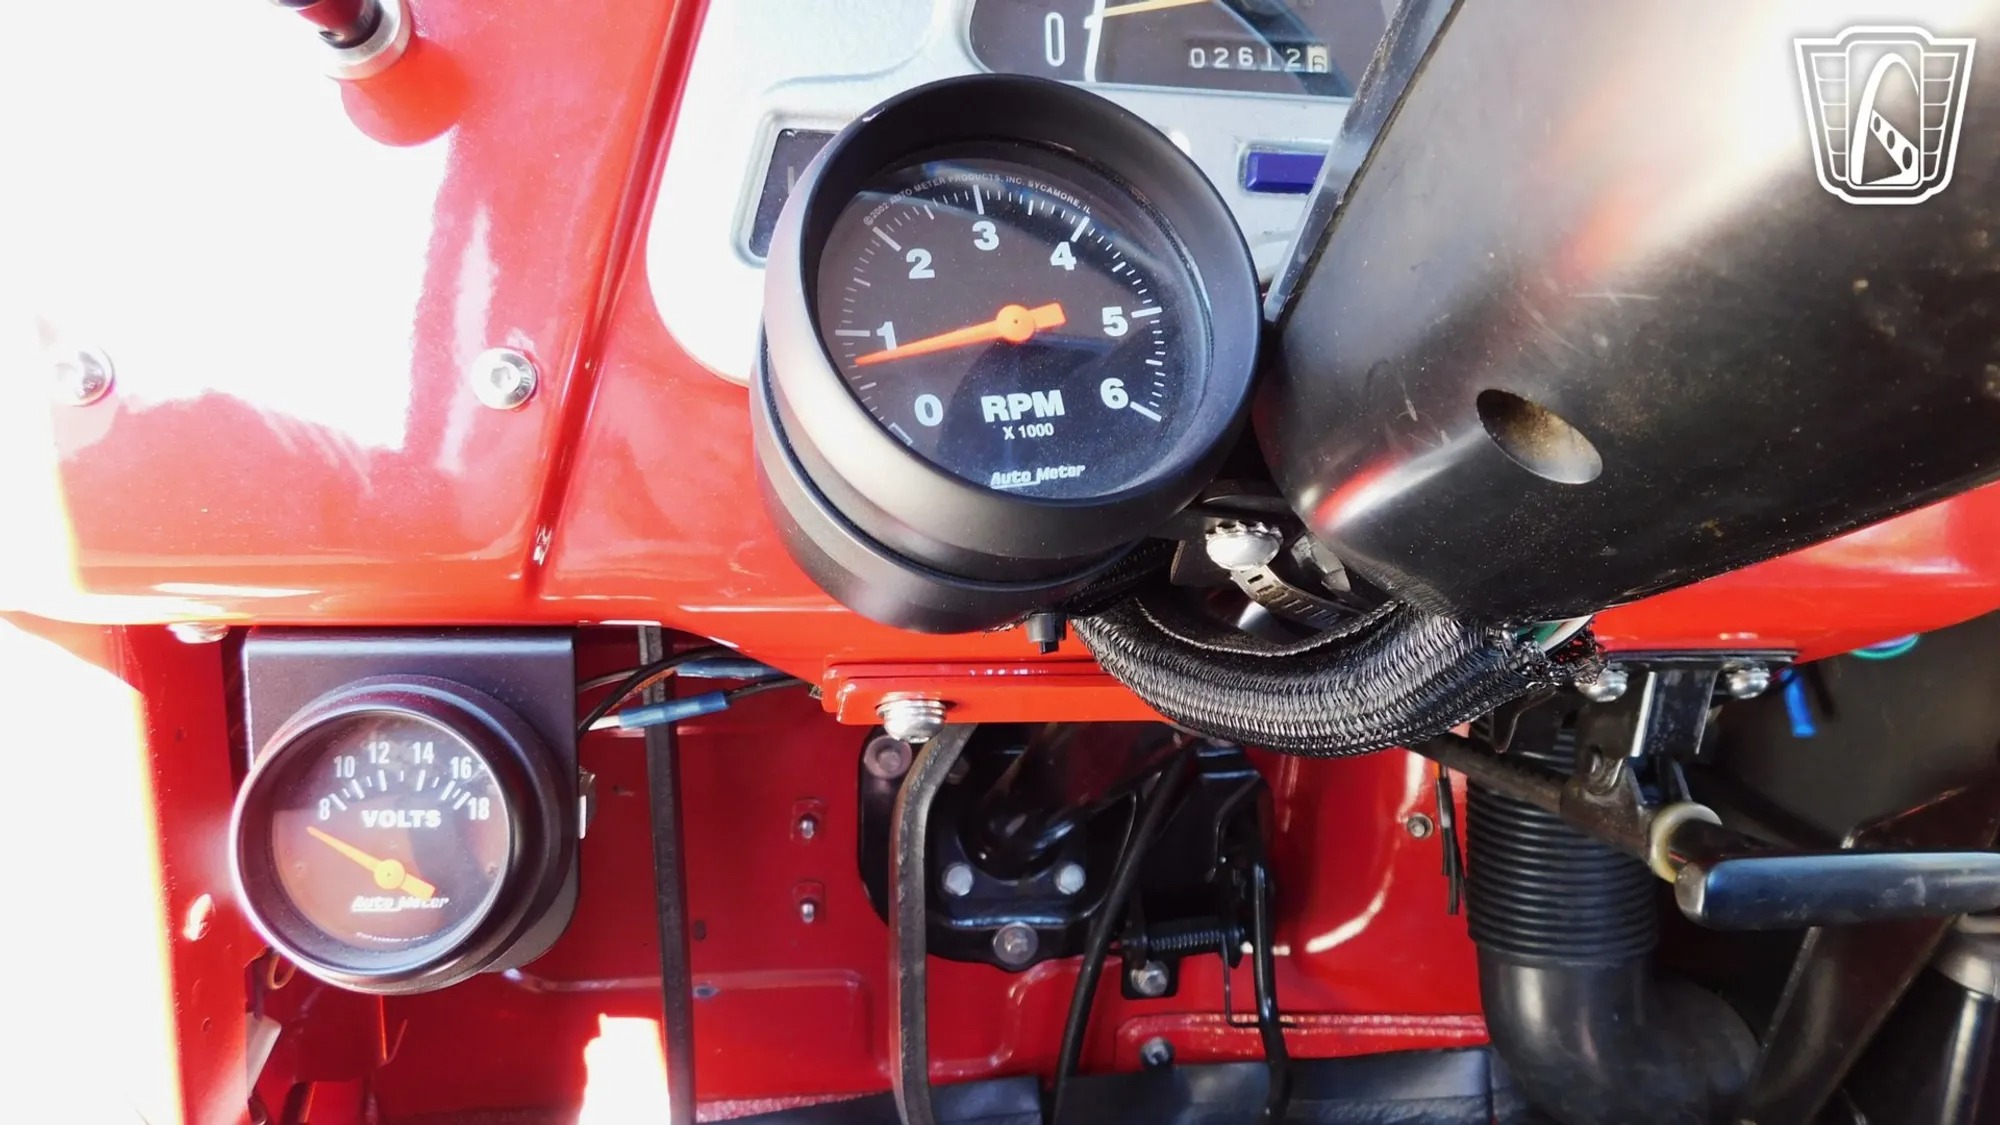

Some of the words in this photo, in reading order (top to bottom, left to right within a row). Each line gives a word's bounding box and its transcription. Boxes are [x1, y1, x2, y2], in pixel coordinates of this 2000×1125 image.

[914, 177, 946, 192] METER
[972, 221, 999, 250] 3
[906, 249, 935, 279] 2
[1050, 242, 1077, 270] 4
[1102, 306, 1129, 336] 5
[876, 321, 897, 350] 1
[1100, 378, 1129, 409] 6
[914, 394, 943, 426] 0
[981, 390, 1065, 422] RPM
[1003, 427, 1015, 440] X
[1018, 423, 1054, 439] 1000
[991, 470, 1032, 488] Auto
[1036, 464, 1085, 483] Meter
[369, 742, 390, 764] 12
[413, 742, 434, 764] 14
[334, 756, 355, 778] 10
[451, 757, 472, 779] 16
[319, 799, 330, 820] 8
[361, 810, 441, 828] VOLTS
[468, 798, 489, 820] 18
